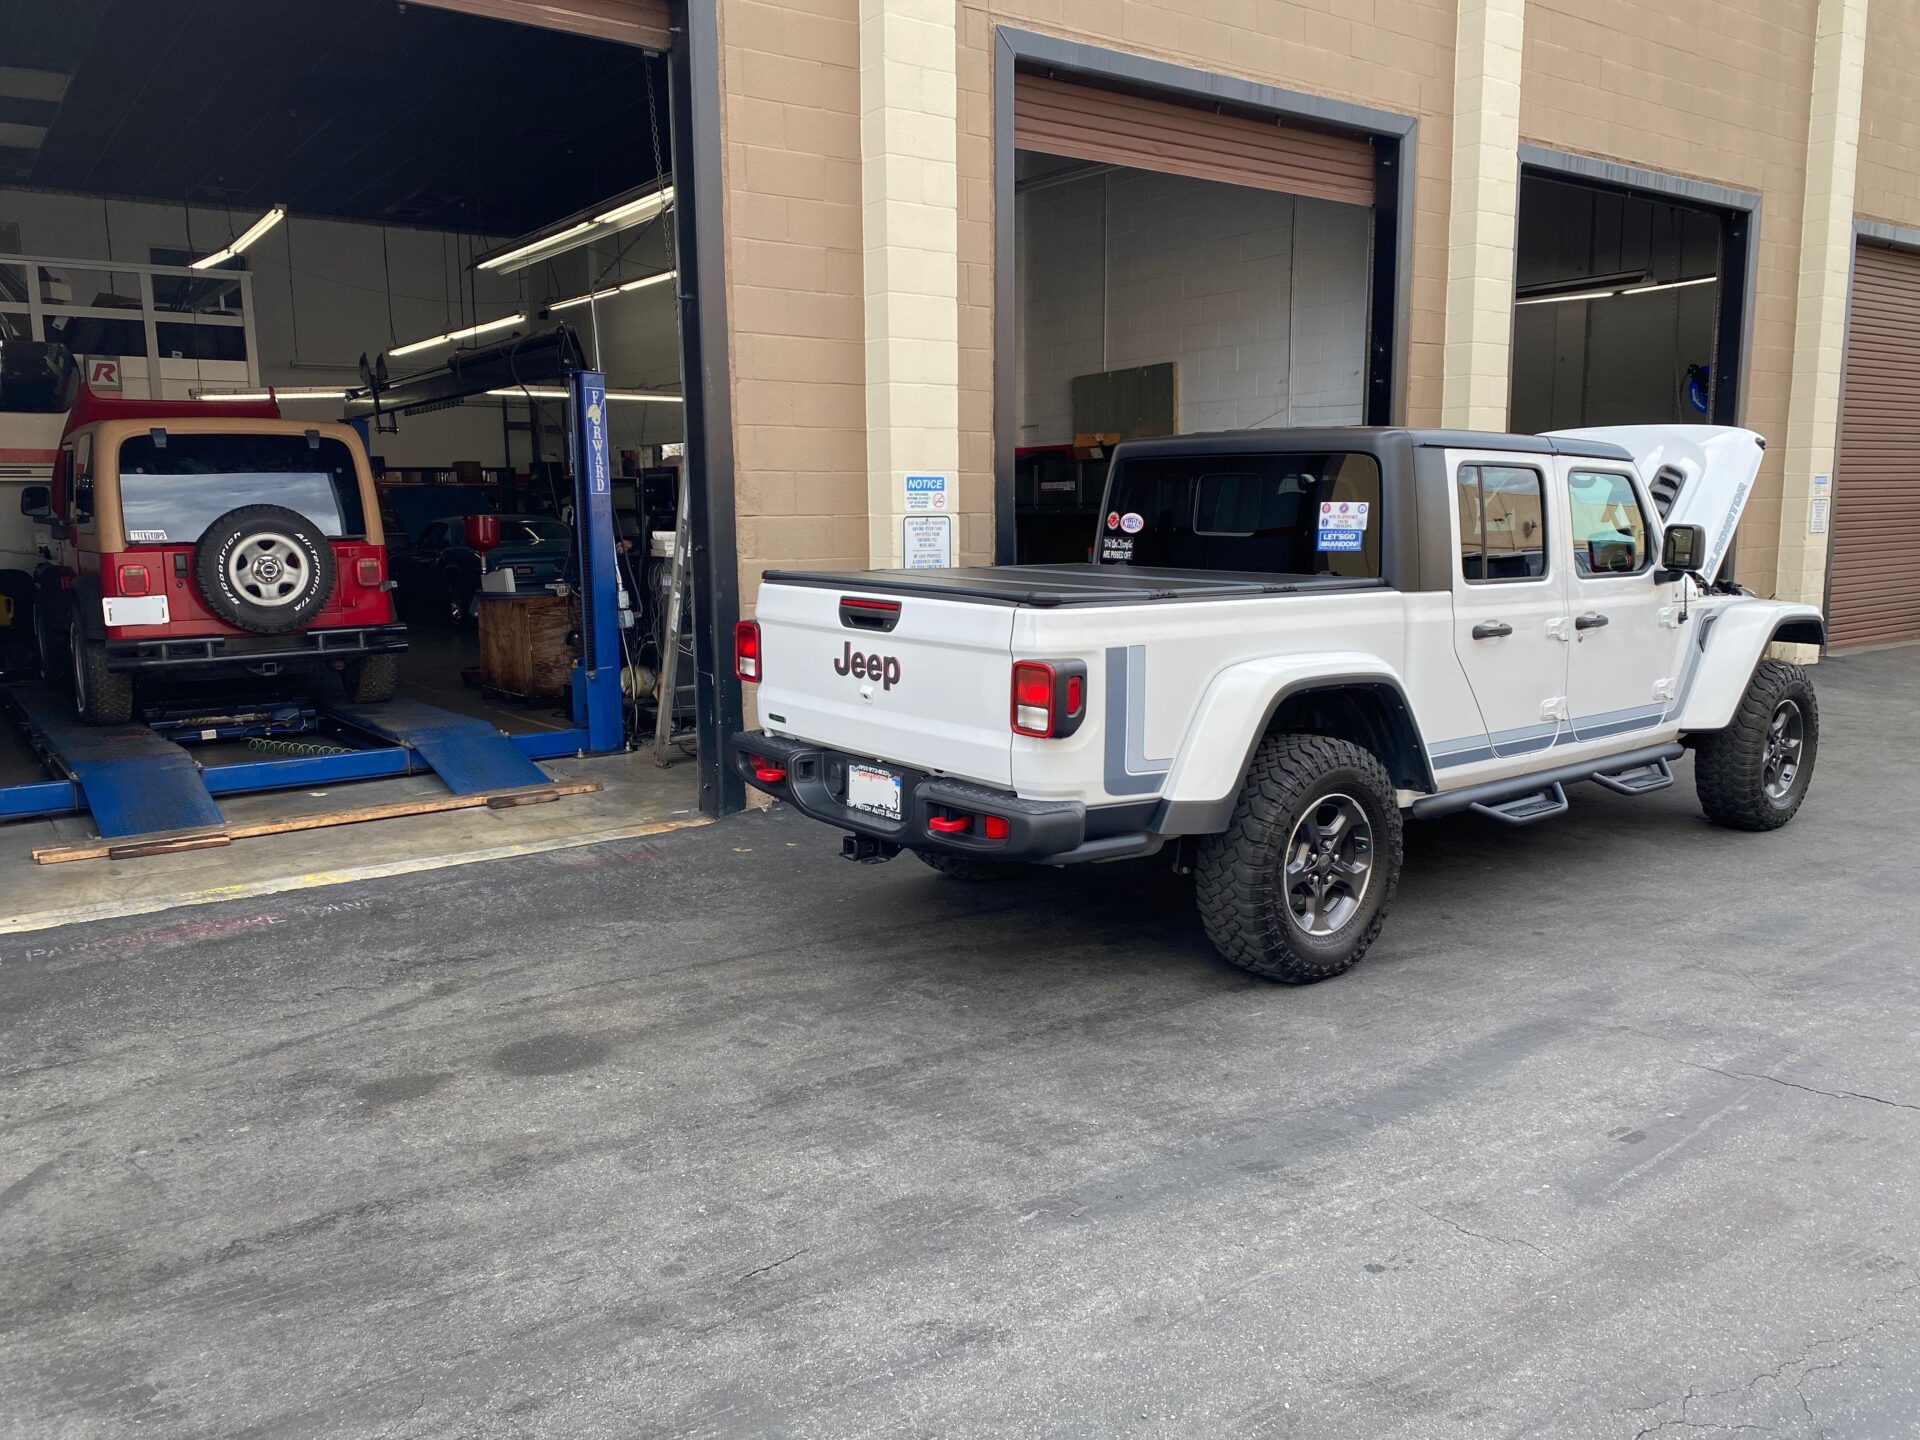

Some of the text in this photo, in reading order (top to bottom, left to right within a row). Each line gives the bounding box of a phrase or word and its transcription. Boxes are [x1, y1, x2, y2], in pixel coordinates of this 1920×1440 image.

[91, 363, 118, 384] R
[587, 390, 606, 492] FORWARD
[908, 479, 943, 489] NOTICE
[1703, 481, 1748, 581] GLADIATOR
[294, 533, 321, 595] All-Terrain
[1124, 550, 1132, 559] OFF
[834, 641, 901, 691] Jeep
[872, 807, 885, 816] AUTO
[885, 810, 901, 820] SALES
